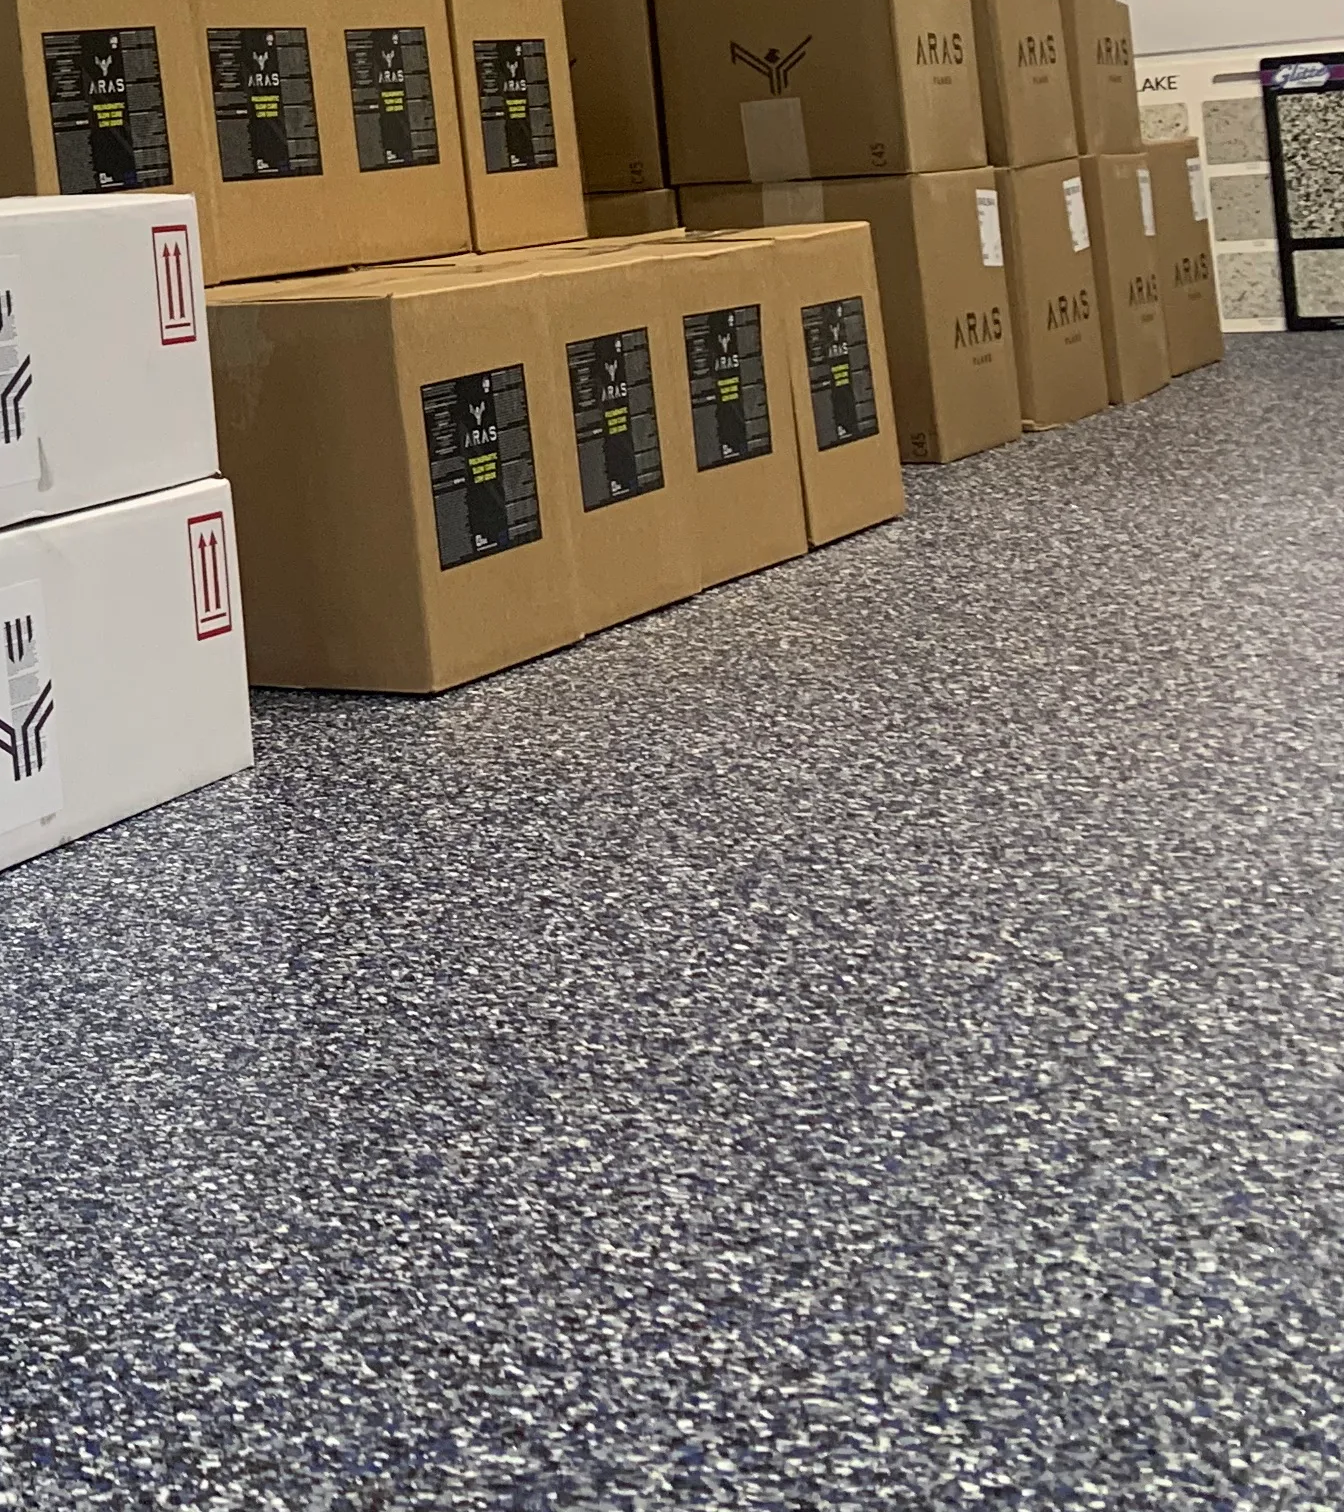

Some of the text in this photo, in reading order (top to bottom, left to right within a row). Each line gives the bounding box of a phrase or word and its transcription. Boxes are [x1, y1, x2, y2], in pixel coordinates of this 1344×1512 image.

[916, 33, 963, 65] ARAS
[1018, 35, 1056, 67] ARAS
[89, 78, 125, 95] ARAS
[247, 73, 279, 87] ARAS
[378, 69, 404, 84] ARAS
[1047, 289, 1090, 331] ARAS
[954, 306, 1002, 349] ARAS
[602, 383, 628, 402] ARAS
[465, 426, 497, 448] ARAS
